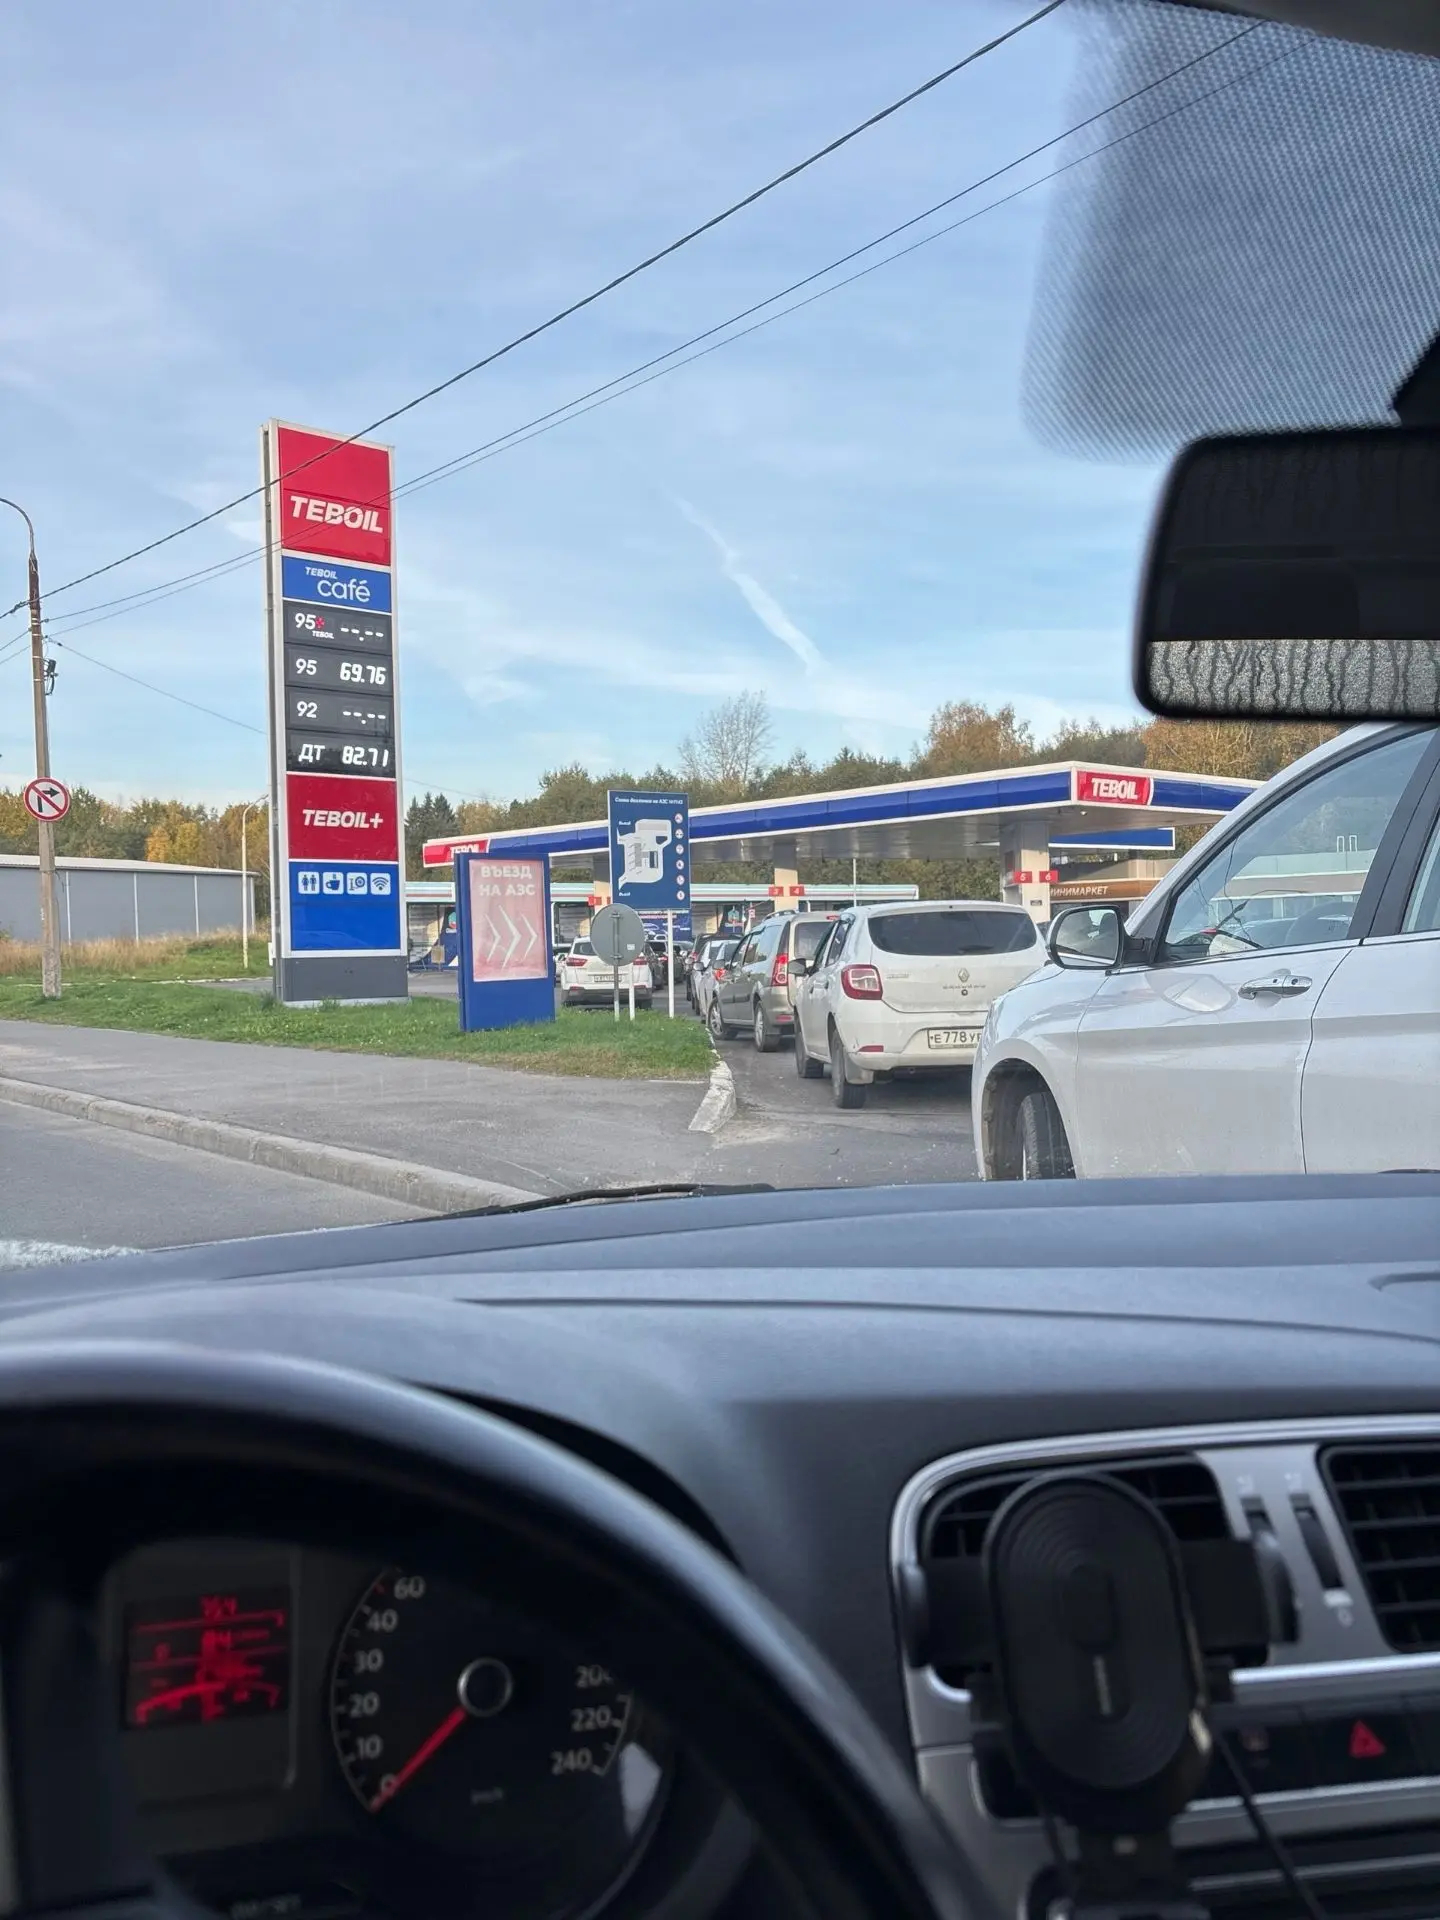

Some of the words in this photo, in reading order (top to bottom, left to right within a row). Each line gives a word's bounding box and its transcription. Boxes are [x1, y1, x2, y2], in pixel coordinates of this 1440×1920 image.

[290, 495, 384, 533] TEBOIL
[305, 566, 337, 580] TEBOIL
[317, 579, 371, 603] café
[295, 613, 316, 630] 95
[312, 630, 335, 640] TEBOIL
[295, 658, 318, 676] 95
[339, 662, 387, 685] 69.76
[297, 701, 318, 719] 92
[298, 743, 326, 763] ДТ
[342, 745, 389, 767] 82.71
[1091, 777, 1138, 800] TEBOIL
[302, 809, 384, 829] TEBOIL+
[481, 865, 532, 879] ВЪЕЗД
[479, 884, 501, 896] НА
[505, 884, 536, 896] АЗС
[366, 1609, 398, 1632] 40
[354, 1648, 384, 1673] 30
[350, 1691, 380, 1718] 20
[570, 1705, 612, 1732] 220
[356, 1734, 383, 1759] 10
[550, 1747, 593, 1776] 240
